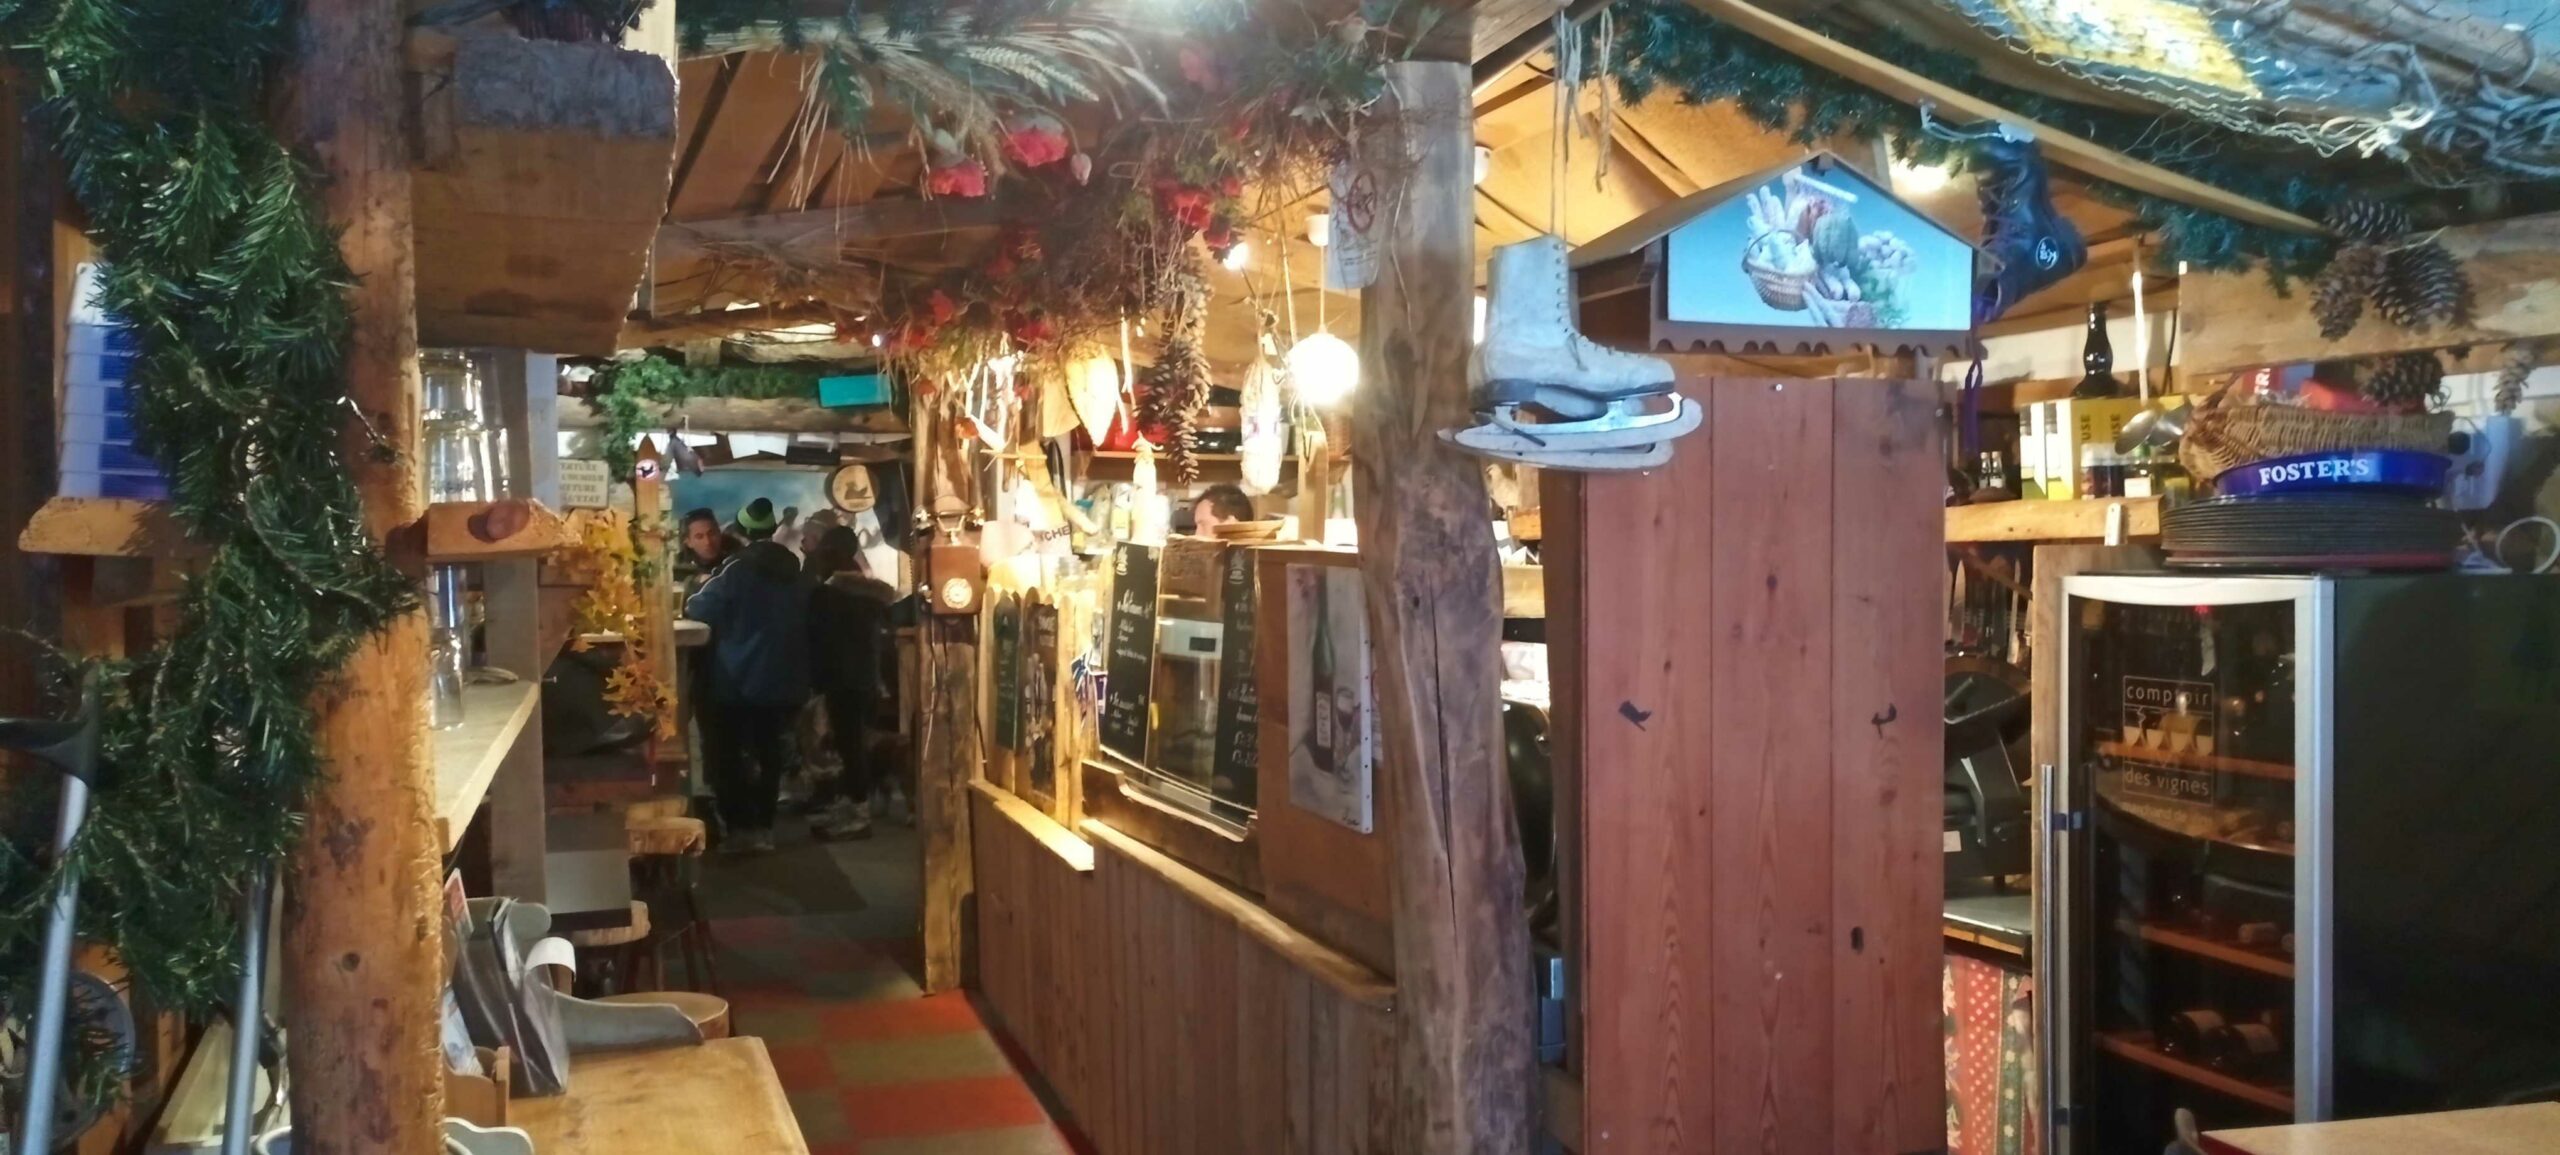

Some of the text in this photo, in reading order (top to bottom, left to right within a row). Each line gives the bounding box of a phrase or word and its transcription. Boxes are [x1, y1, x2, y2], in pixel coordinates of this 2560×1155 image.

[2080, 414, 2092, 441] USE
[2259, 459, 2370, 486] FOSTER'S
[2125, 767, 2209, 797] des vignes
